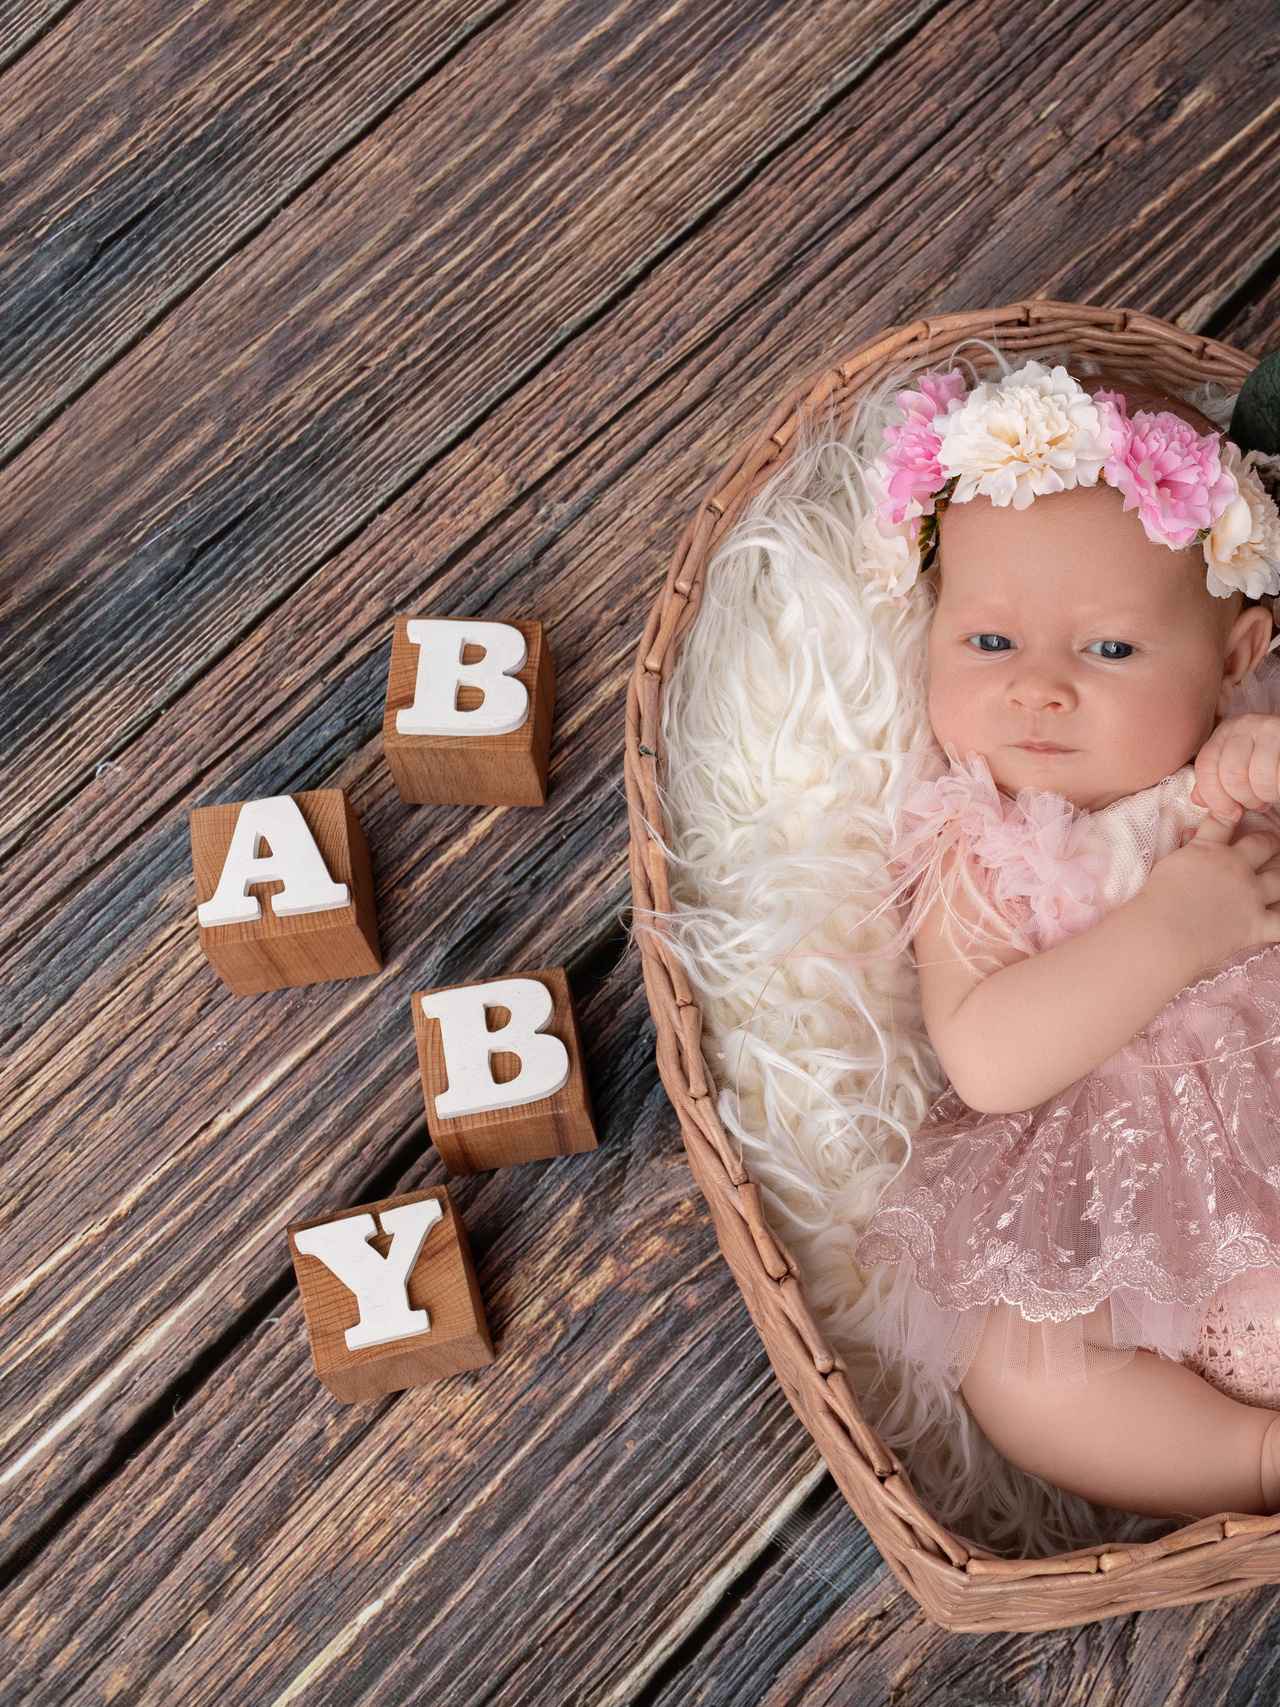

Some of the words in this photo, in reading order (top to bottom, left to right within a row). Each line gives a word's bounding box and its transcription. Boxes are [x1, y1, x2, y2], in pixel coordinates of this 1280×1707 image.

[395, 618, 530, 736] B
[197, 795, 351, 928] A
[421, 977, 571, 1120] B
[293, 1198, 445, 1352] Y
